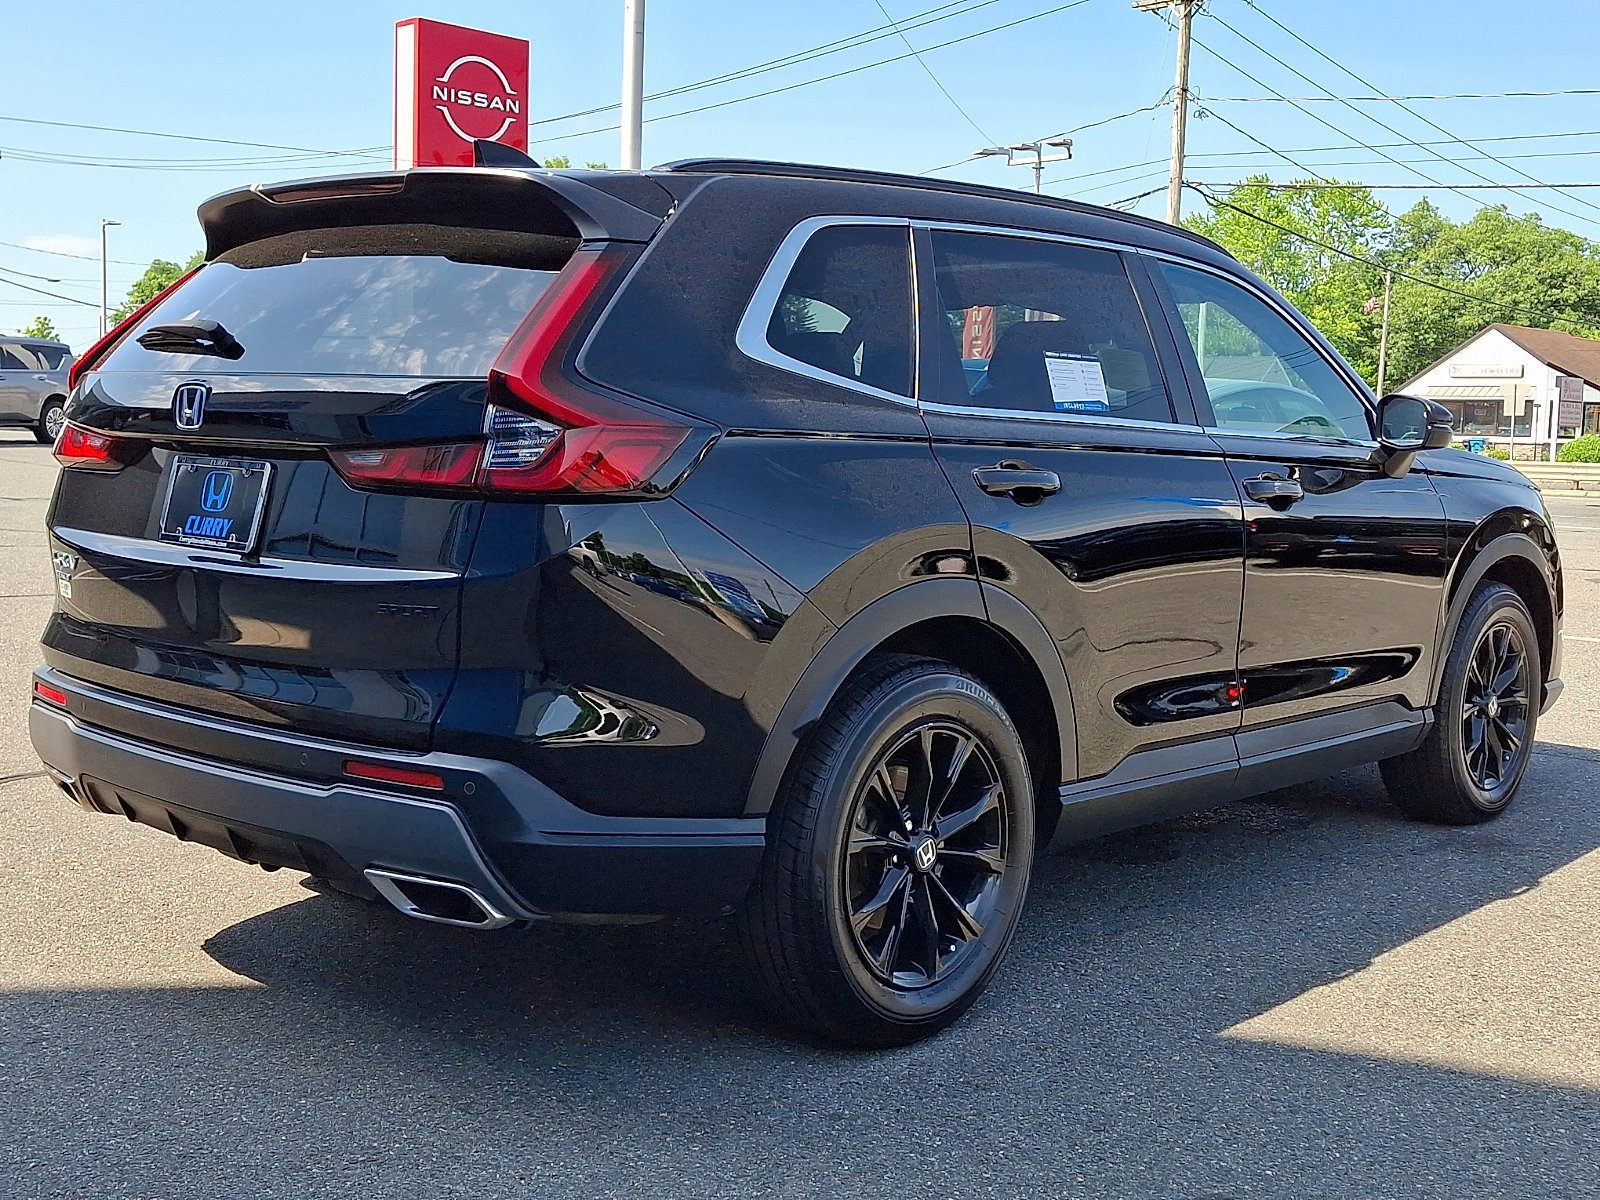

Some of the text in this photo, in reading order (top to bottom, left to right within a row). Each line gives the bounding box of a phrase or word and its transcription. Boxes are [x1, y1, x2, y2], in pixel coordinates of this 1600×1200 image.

[433, 85, 520, 114] NISSAN
[210, 459, 230, 467] CURRY
[184, 515, 234, 538] CURRY
